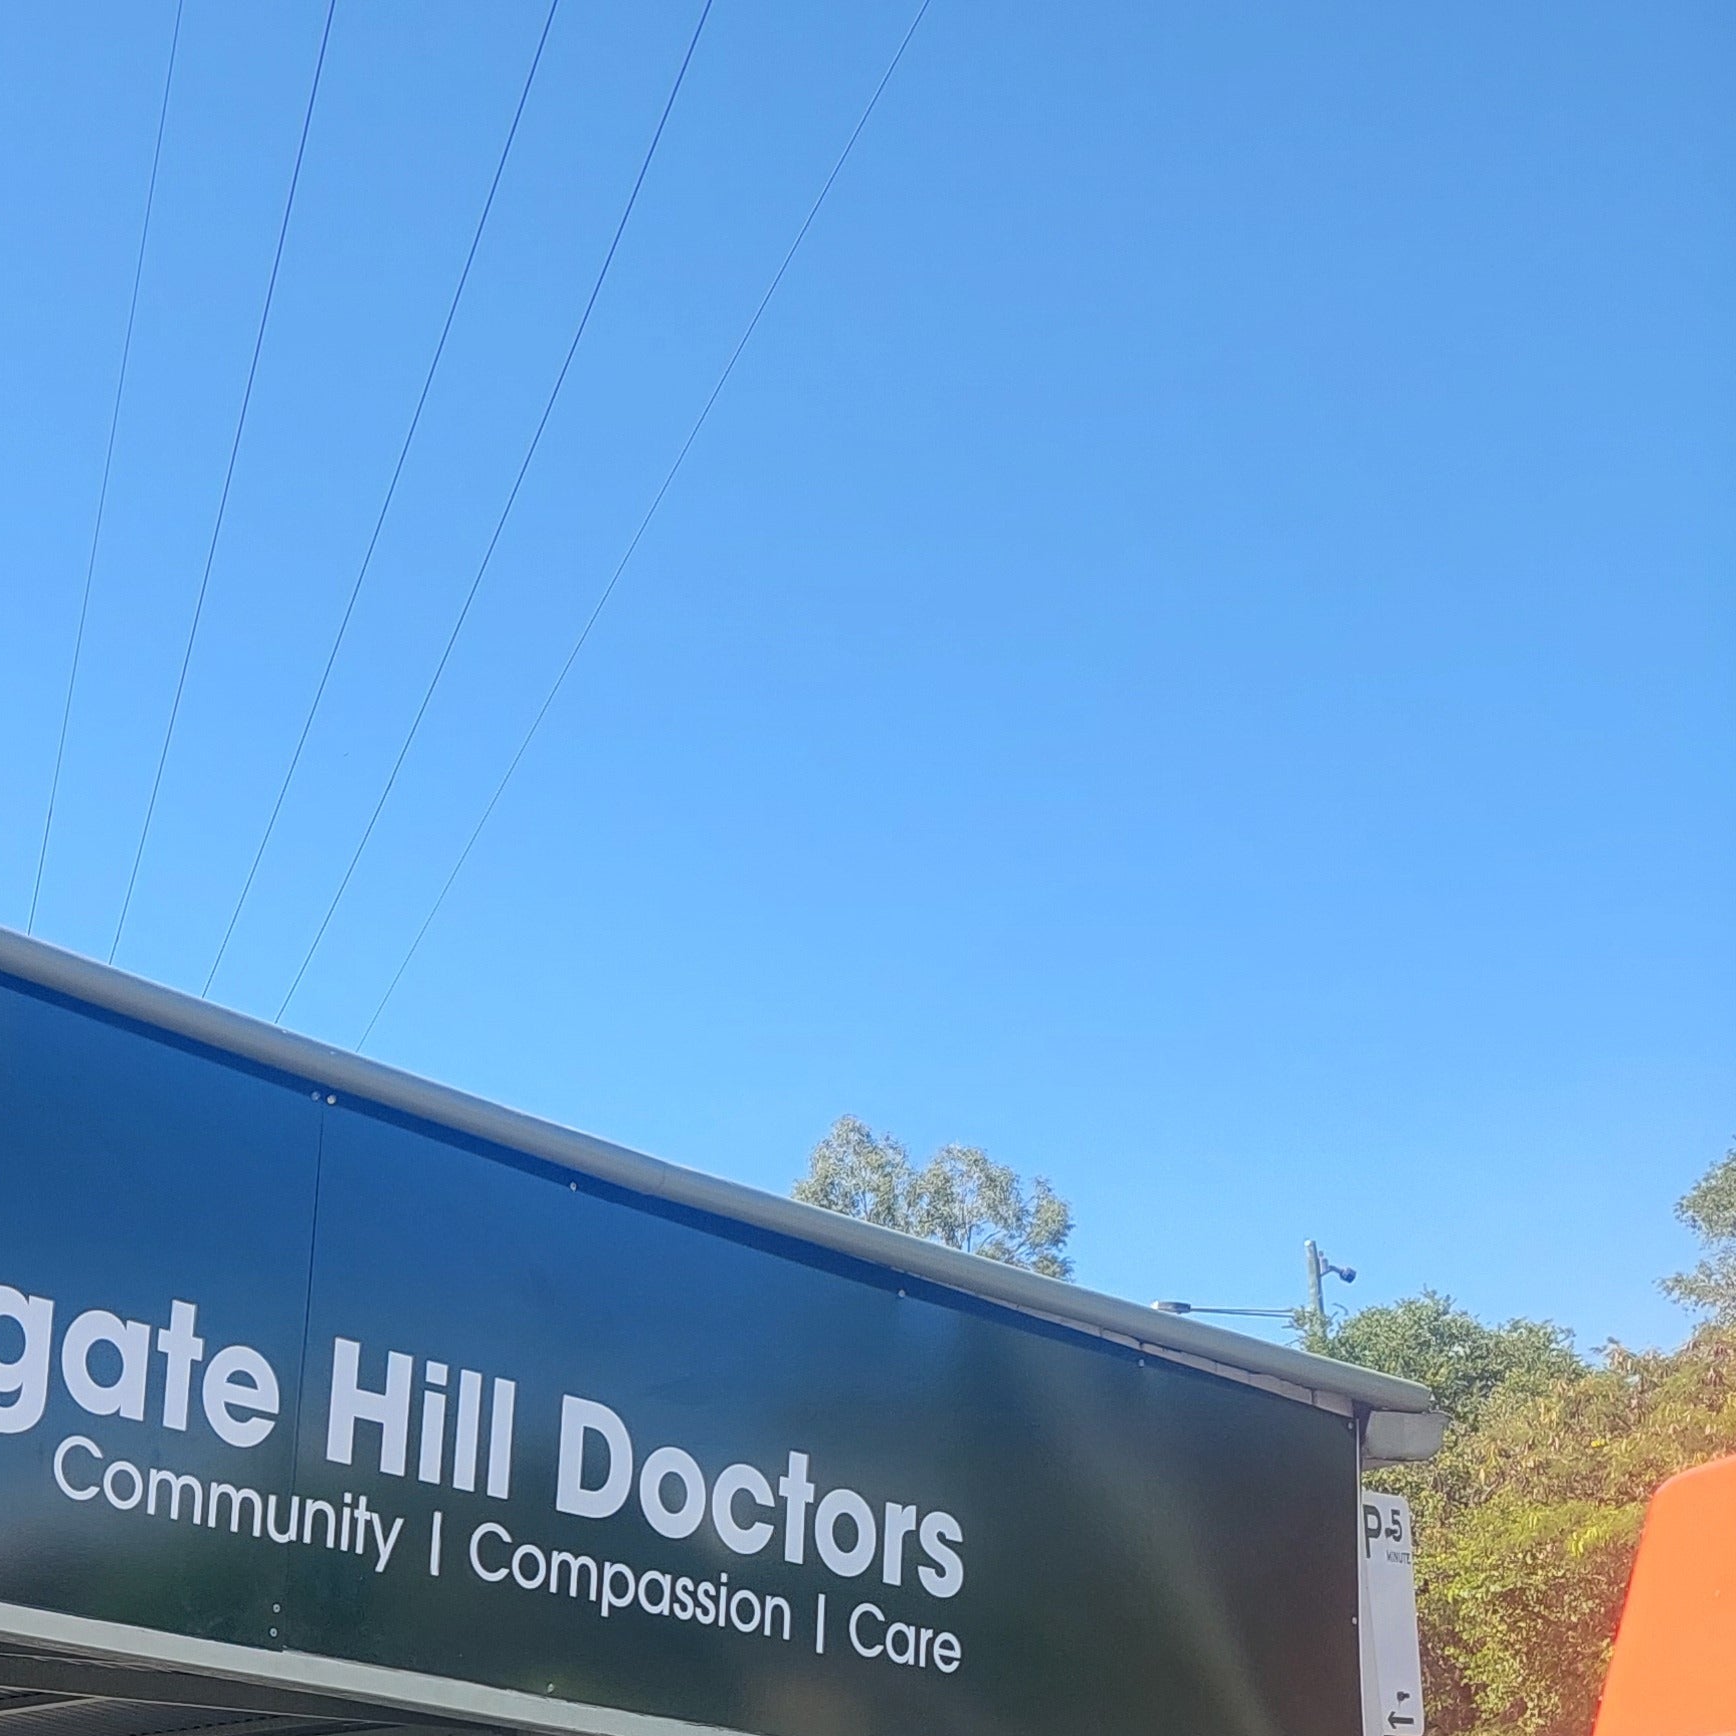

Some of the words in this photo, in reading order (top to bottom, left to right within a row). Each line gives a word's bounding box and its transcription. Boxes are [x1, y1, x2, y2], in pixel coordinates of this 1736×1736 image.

[52, 1434, 405, 1574] Community
[468, 1520, 792, 1641] Compassion
[847, 1601, 963, 1675] Care
[324, 1336, 517, 1500] Hill
[555, 1393, 965, 1599] Doctors
[1362, 1503, 1383, 1559] P
